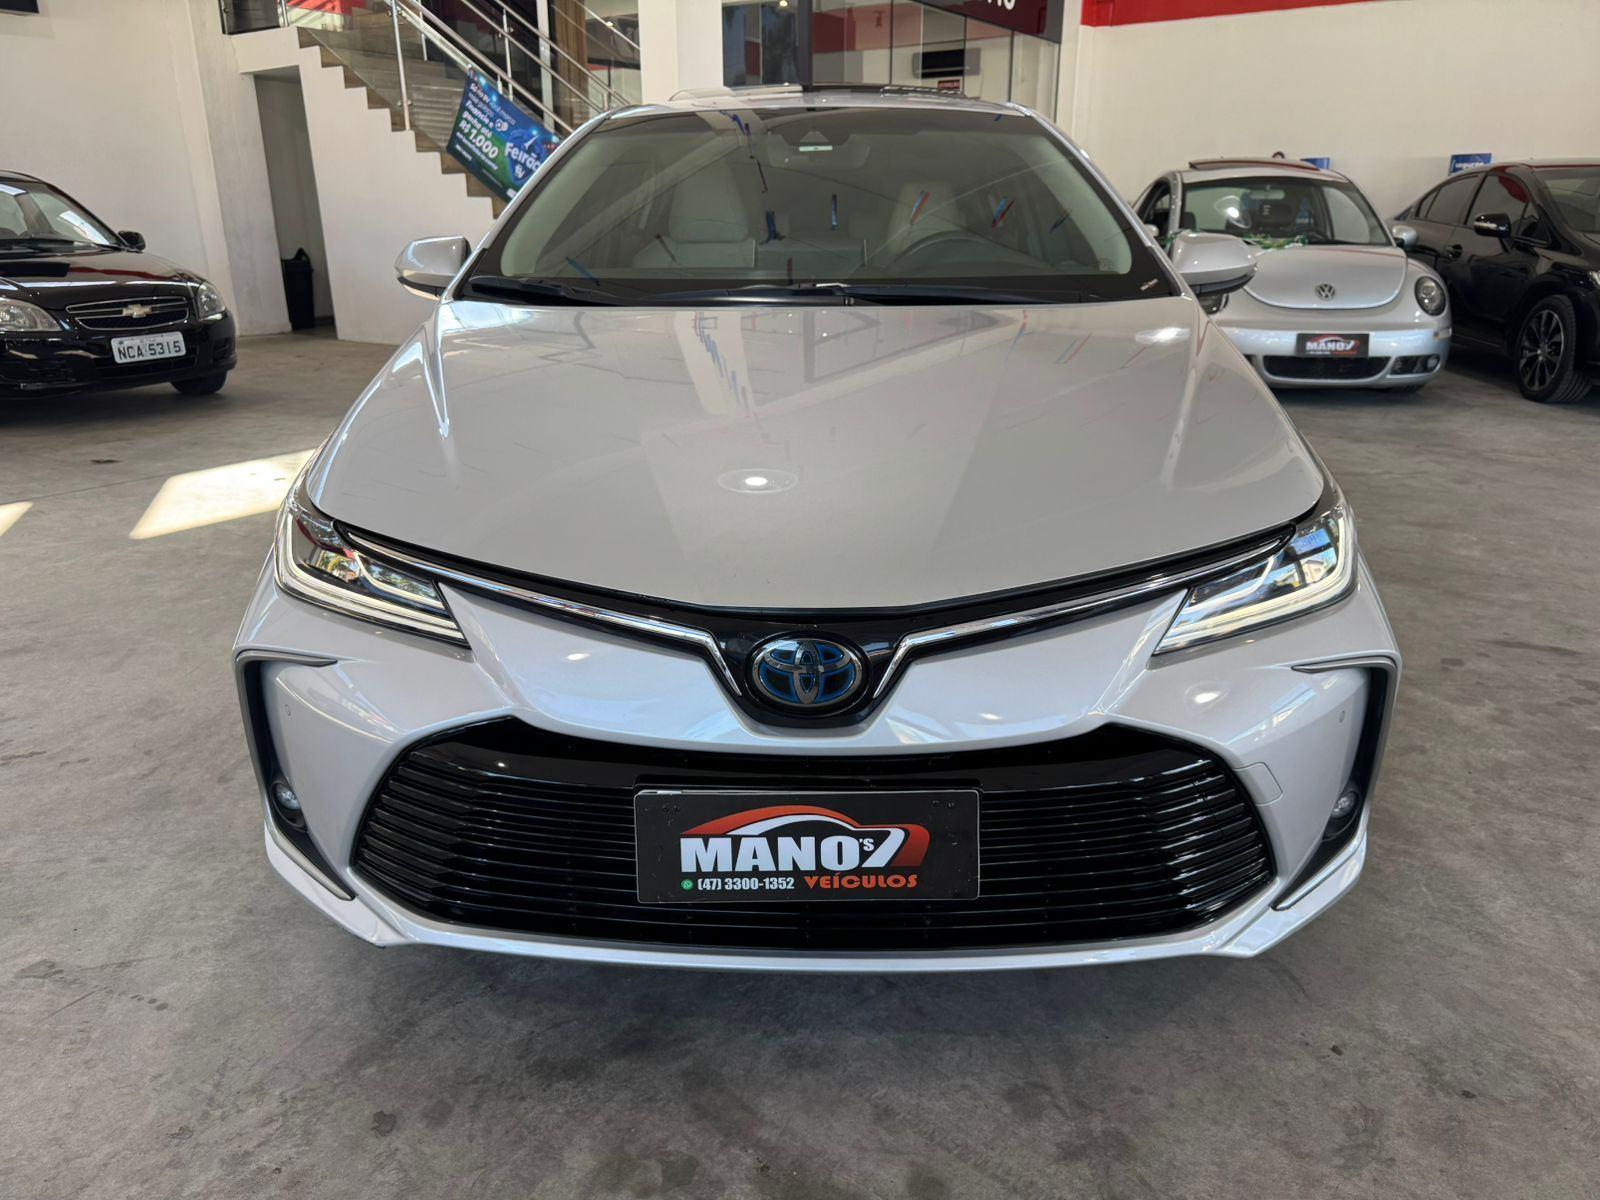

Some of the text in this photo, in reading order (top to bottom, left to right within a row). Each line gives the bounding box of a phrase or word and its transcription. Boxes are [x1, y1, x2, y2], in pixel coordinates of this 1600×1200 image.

[459, 120, 471, 134] R$
[468, 129, 499, 158] 1.000
[118, 340, 182, 360] NCA 5315
[697, 876, 795, 891] (47) 3300-1352
[804, 873, 919, 889] VEÍCULOS
